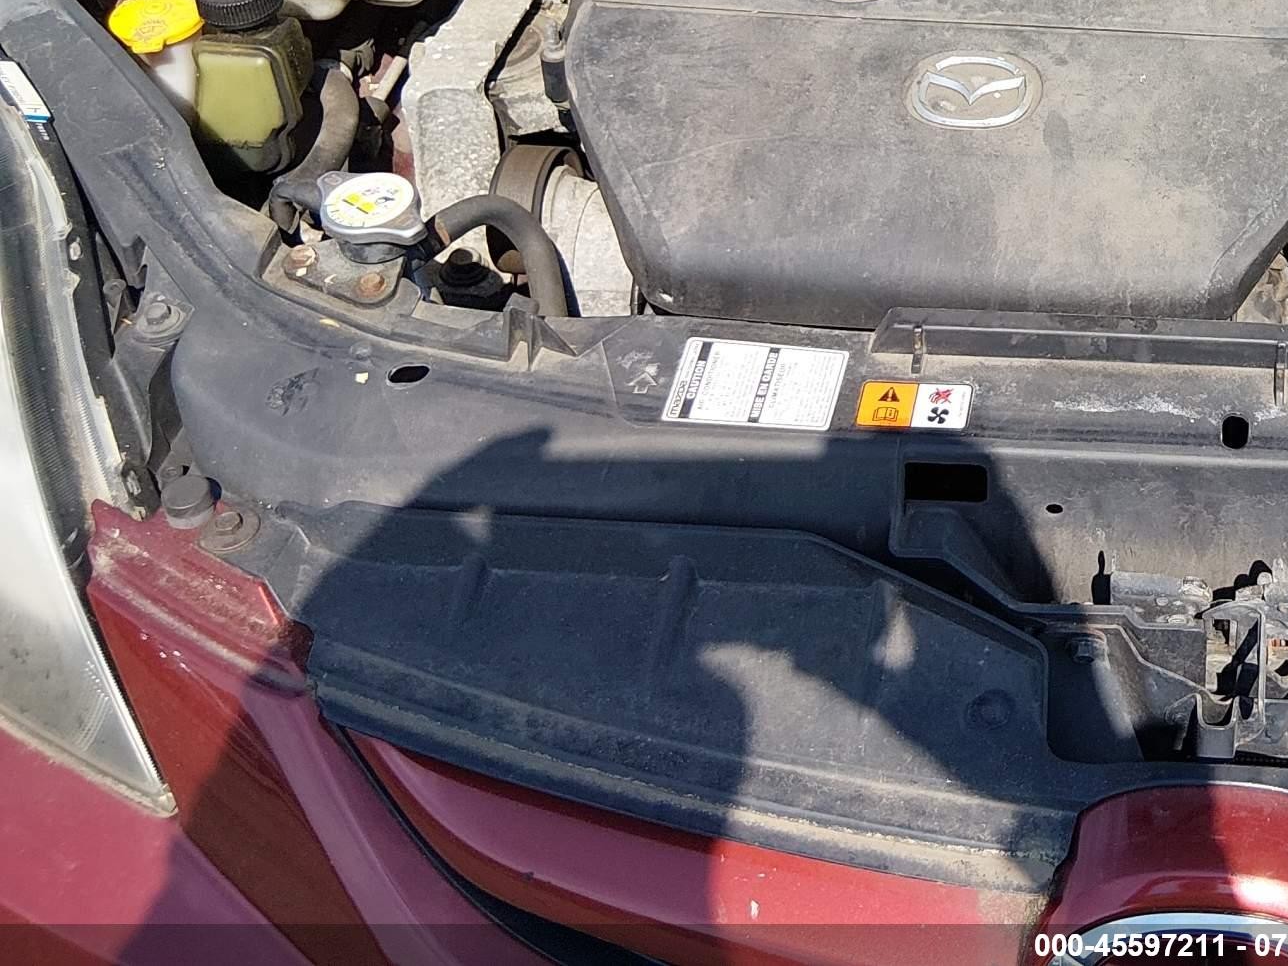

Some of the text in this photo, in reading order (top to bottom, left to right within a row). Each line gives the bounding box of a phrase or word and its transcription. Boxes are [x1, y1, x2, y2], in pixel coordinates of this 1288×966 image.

[686, 360, 707, 400] CAUTION
[750, 396, 765, 418] MISE
[762, 351, 780, 381] GARDE
